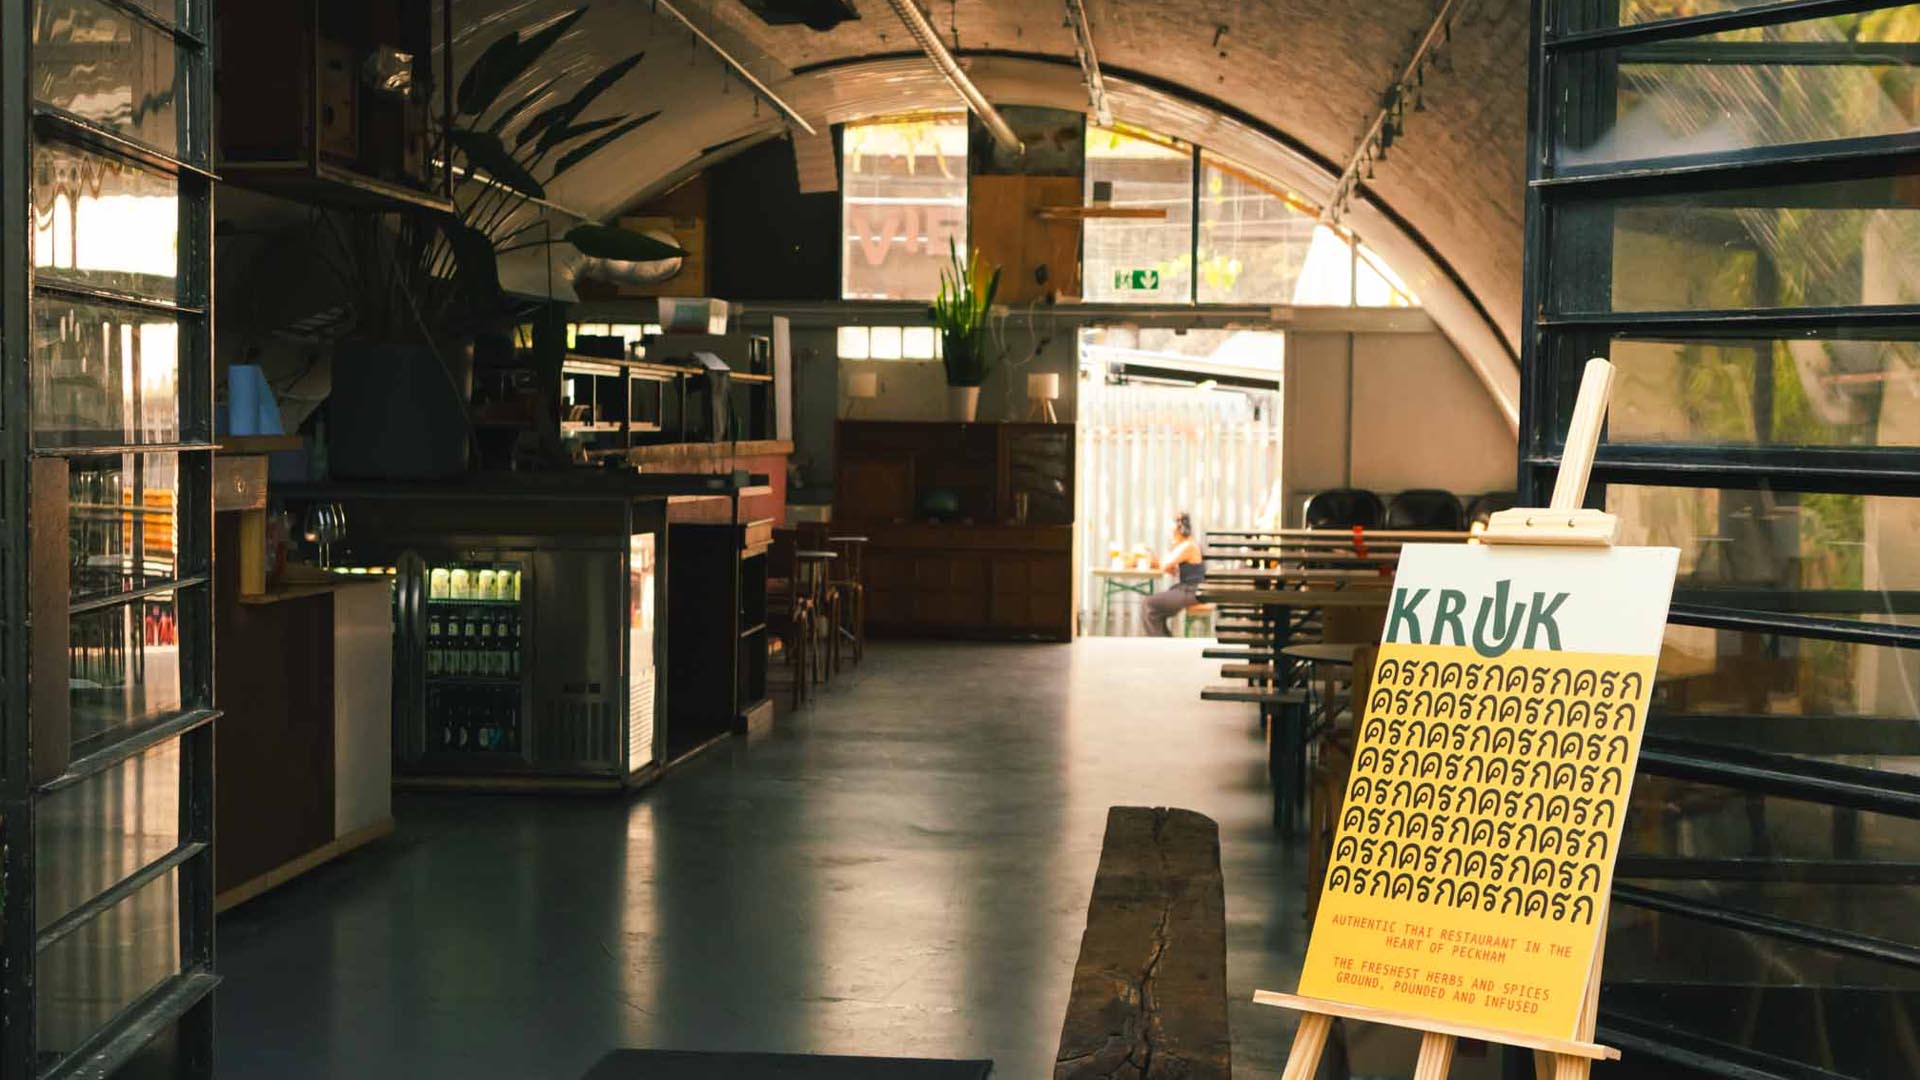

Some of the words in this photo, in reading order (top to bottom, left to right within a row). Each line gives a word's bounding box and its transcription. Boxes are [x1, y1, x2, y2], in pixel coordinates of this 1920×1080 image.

[1386, 579, 1570, 658] KRUK
[1331, 914, 1396, 933] AUTHENTIC
[1405, 923, 1433, 938] THAI
[1440, 929, 1517, 950] RESTAURANT
[1525, 940, 1540, 953] IN
[1550, 944, 1573, 958] THE
[1385, 936, 1423, 951] HEART
[1429, 942, 1444, 953] OF
[1452, 945, 1506, 964] PECKHAM
[1333, 956, 1354, 969] THE
[1361, 961, 1419, 979] FRESHEST
[1426, 971, 1464, 987] HERBS
[1471, 978, 1495, 992] AND
[1503, 982, 1550, 1001] SPICES
[1393, 981, 1446, 999] POUNDED
[1453, 991, 1475, 1004] AND
[1484, 995, 1538, 1014] INFUSED
